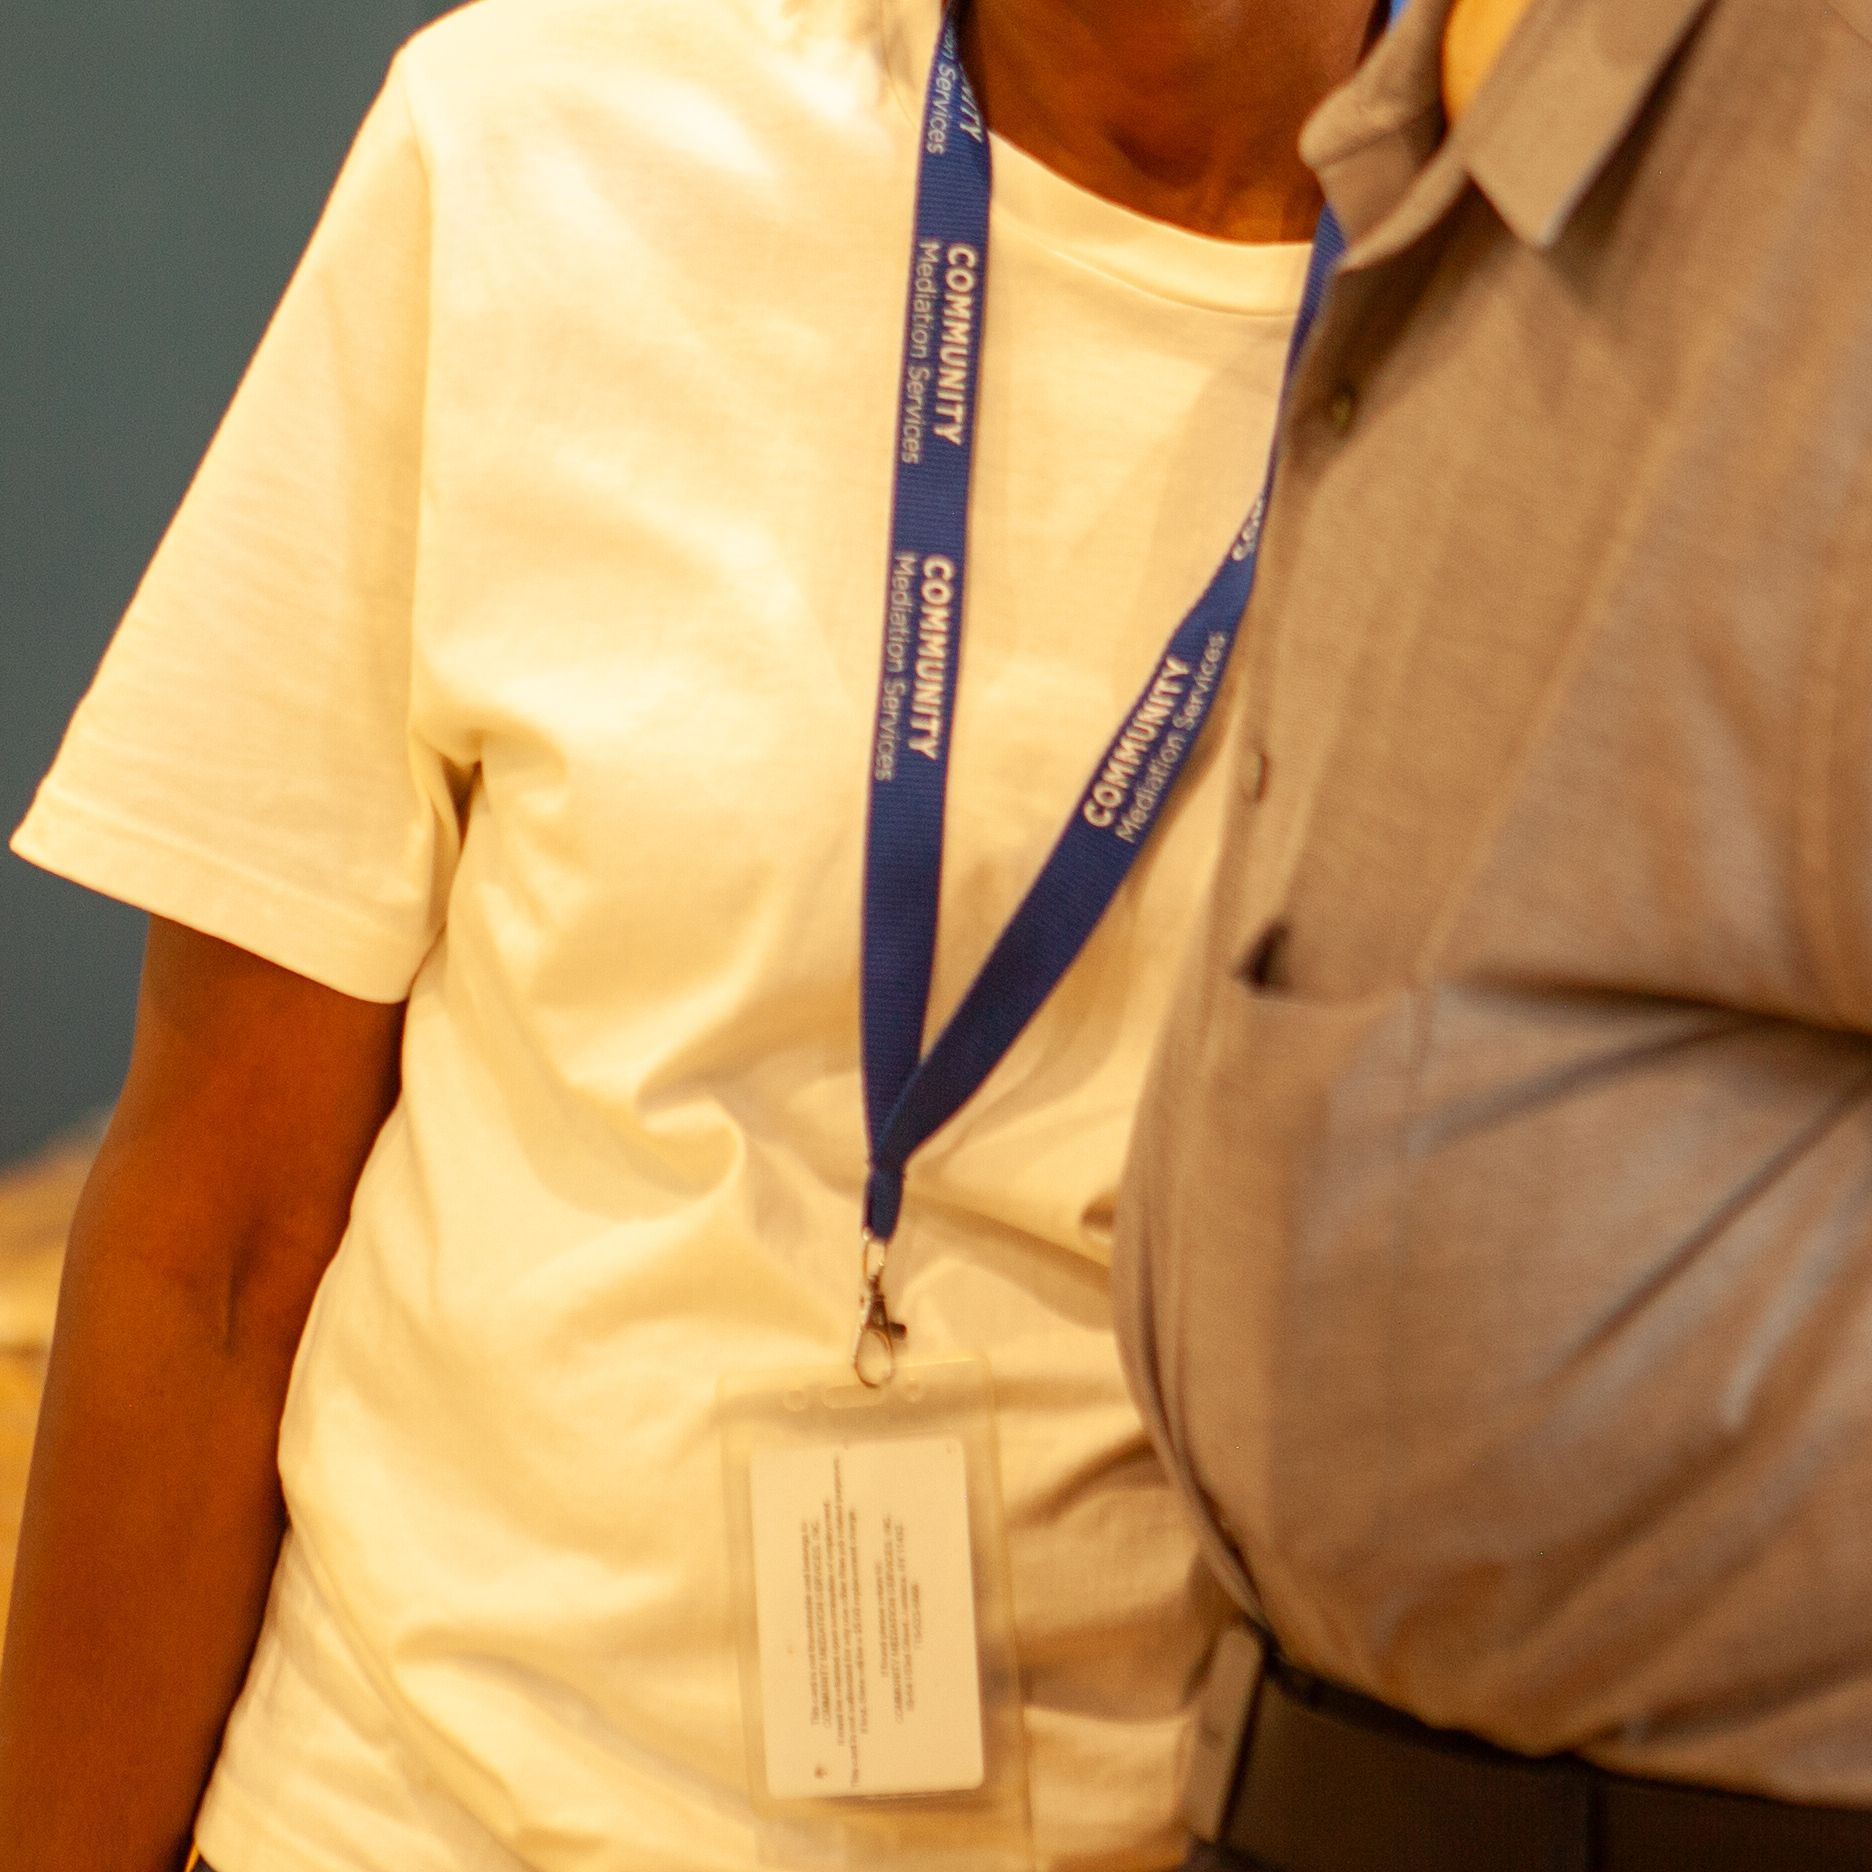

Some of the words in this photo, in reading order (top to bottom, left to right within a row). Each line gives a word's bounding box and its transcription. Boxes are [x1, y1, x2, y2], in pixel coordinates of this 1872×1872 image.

[927, 62, 956, 154] Services
[910, 240, 940, 359] Mediation
[933, 242, 976, 445] COMMUNITY
[901, 366, 930, 464] Services
[887, 552, 916, 672] Mediation
[907, 554, 954, 759] COMMUNITY
[874, 677, 905, 781] Services
[1083, 655, 1188, 828] COMMUNITY
[1114, 731, 1186, 844] Mediation
[1172, 631, 1225, 732] Services
